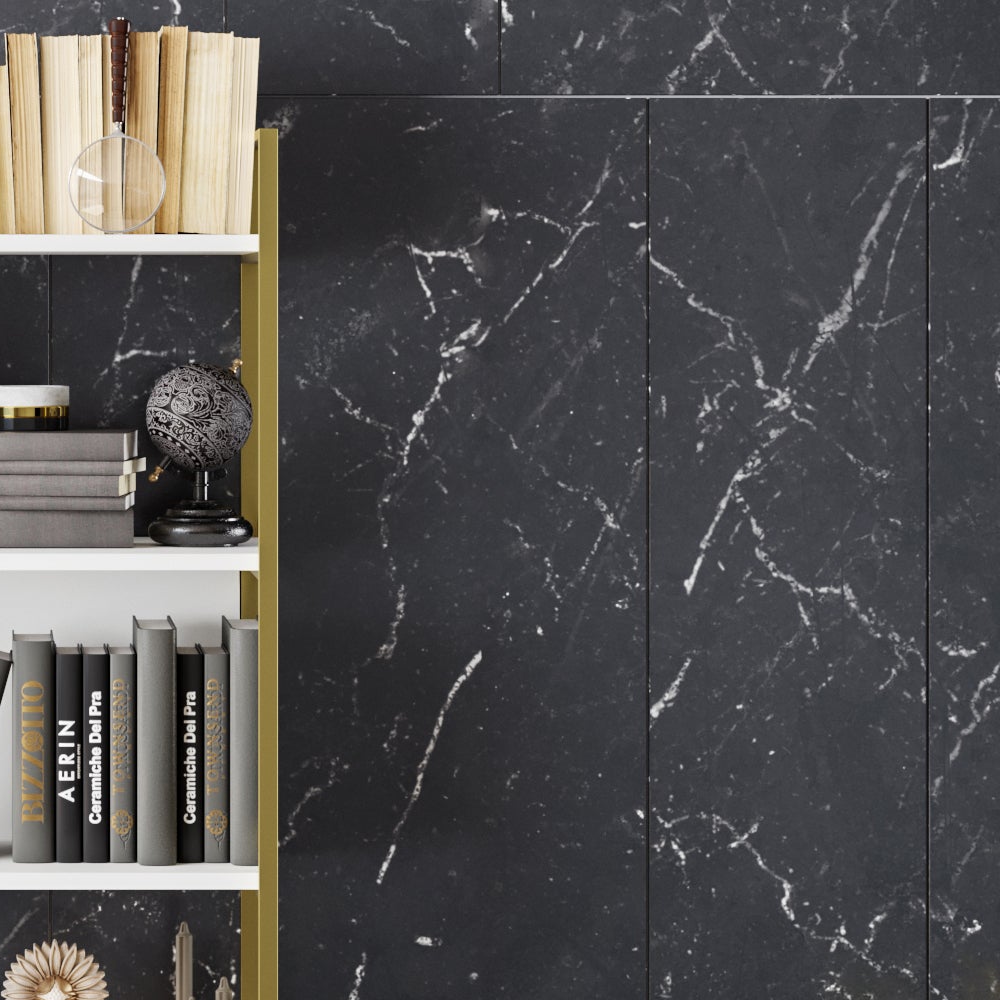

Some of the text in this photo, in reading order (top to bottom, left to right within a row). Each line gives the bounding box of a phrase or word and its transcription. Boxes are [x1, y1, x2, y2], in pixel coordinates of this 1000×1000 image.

[58, 719, 76, 803] AERIN
[88, 690, 103, 825] Ceramiche Del Pra
[112, 678, 125, 796] TOWNSEND
[183, 690, 198, 825] Ceramiche Del Pra
[206, 678, 220, 796] TOWNSEND
